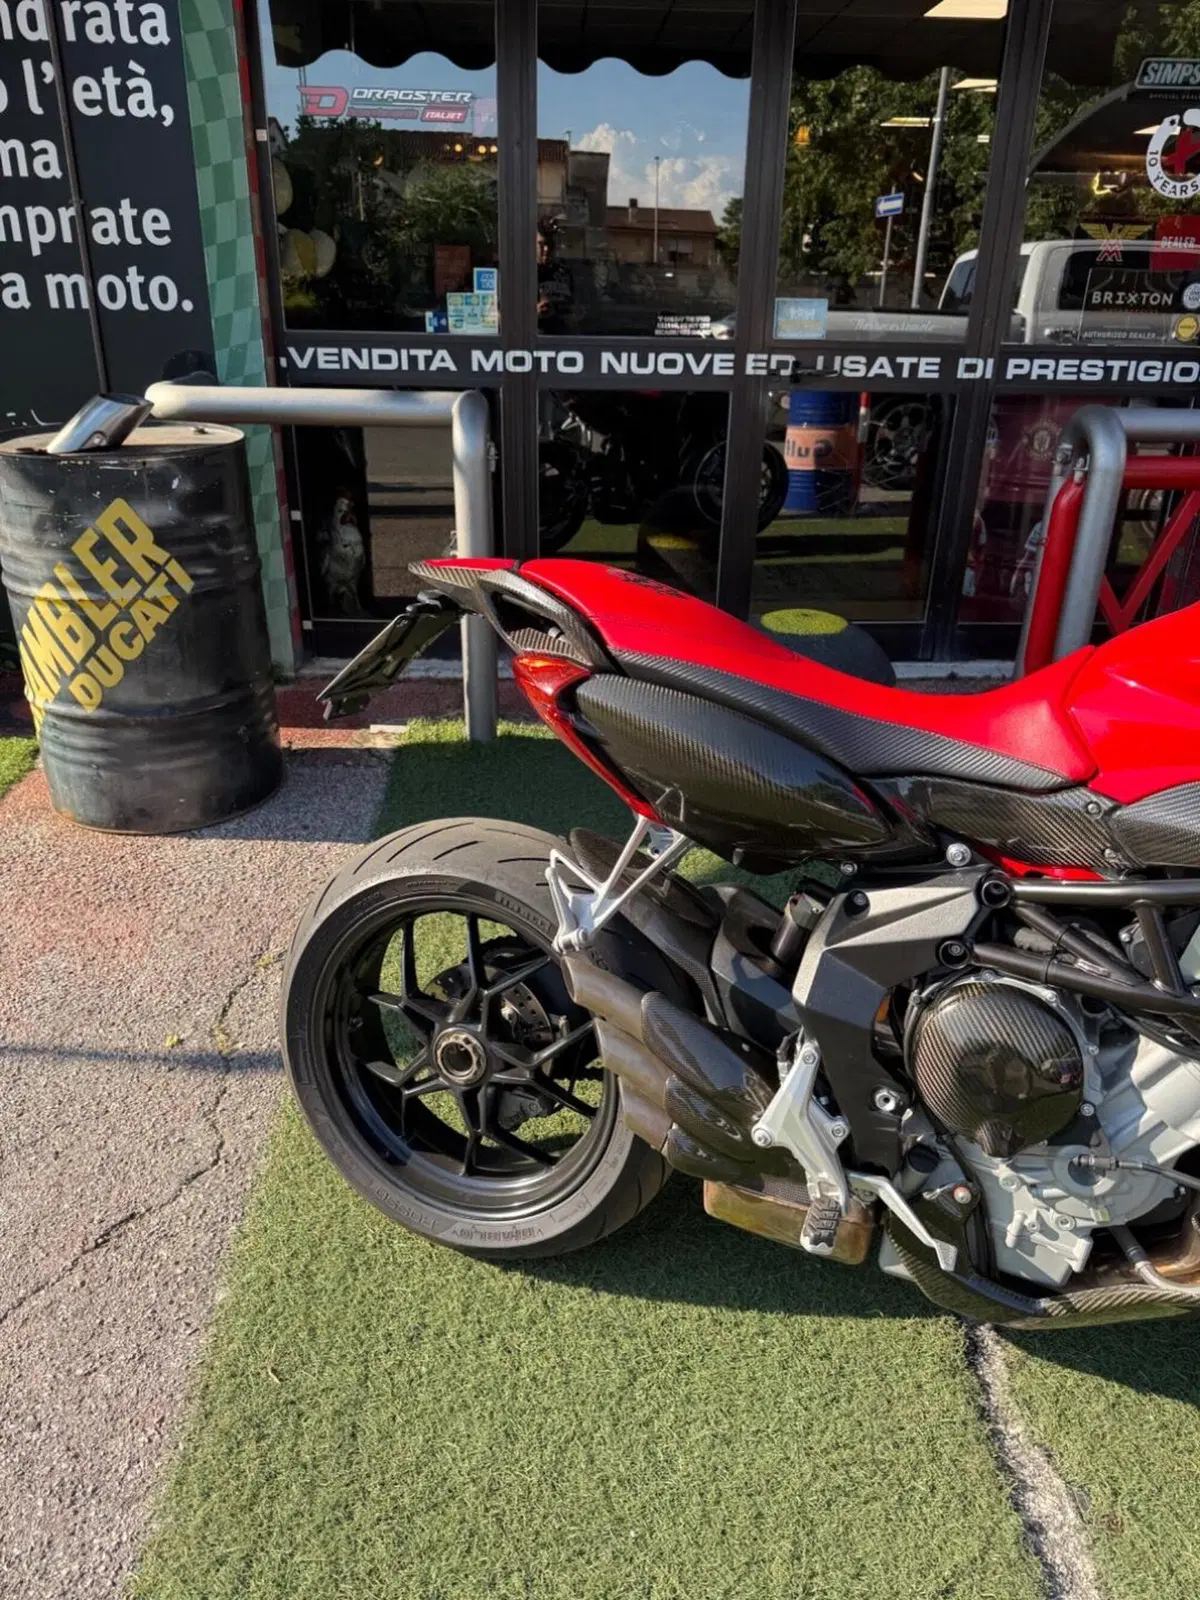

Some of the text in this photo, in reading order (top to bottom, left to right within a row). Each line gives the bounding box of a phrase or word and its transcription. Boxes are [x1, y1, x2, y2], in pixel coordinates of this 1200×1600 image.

[352, 87, 472, 103] DRAGSTER
[1148, 150, 1199, 197] 10 YEARS
[1160, 236, 1196, 249] DEALER
[45, 266, 194, 312] moto.
[1091, 291, 1174, 306] BRIXTON
[287, 346, 457, 372] VENDITA
[471, 350, 584, 374] MOTO
[600, 351, 735, 376] NUOVE
[956, 357, 994, 379] DI
[1005, 358, 1199, 383] PRESTIGIO
[68, 558, 195, 713] DUCATI
